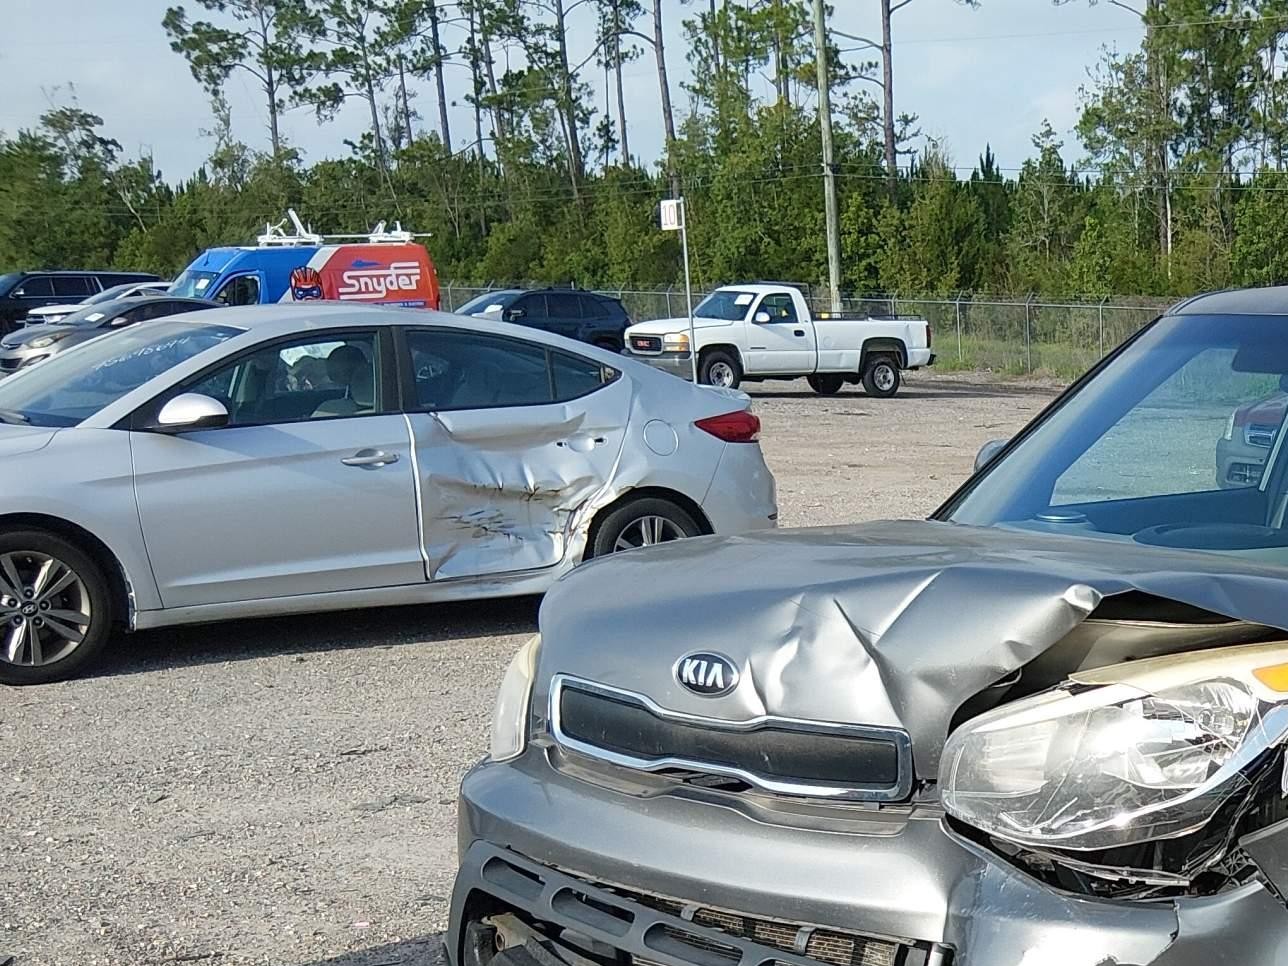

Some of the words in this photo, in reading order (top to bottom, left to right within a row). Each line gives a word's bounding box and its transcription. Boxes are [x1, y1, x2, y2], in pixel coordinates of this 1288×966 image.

[663, 204, 676, 226] 10
[338, 261, 420, 300] Snyder
[682, 658, 725, 689] KIA
